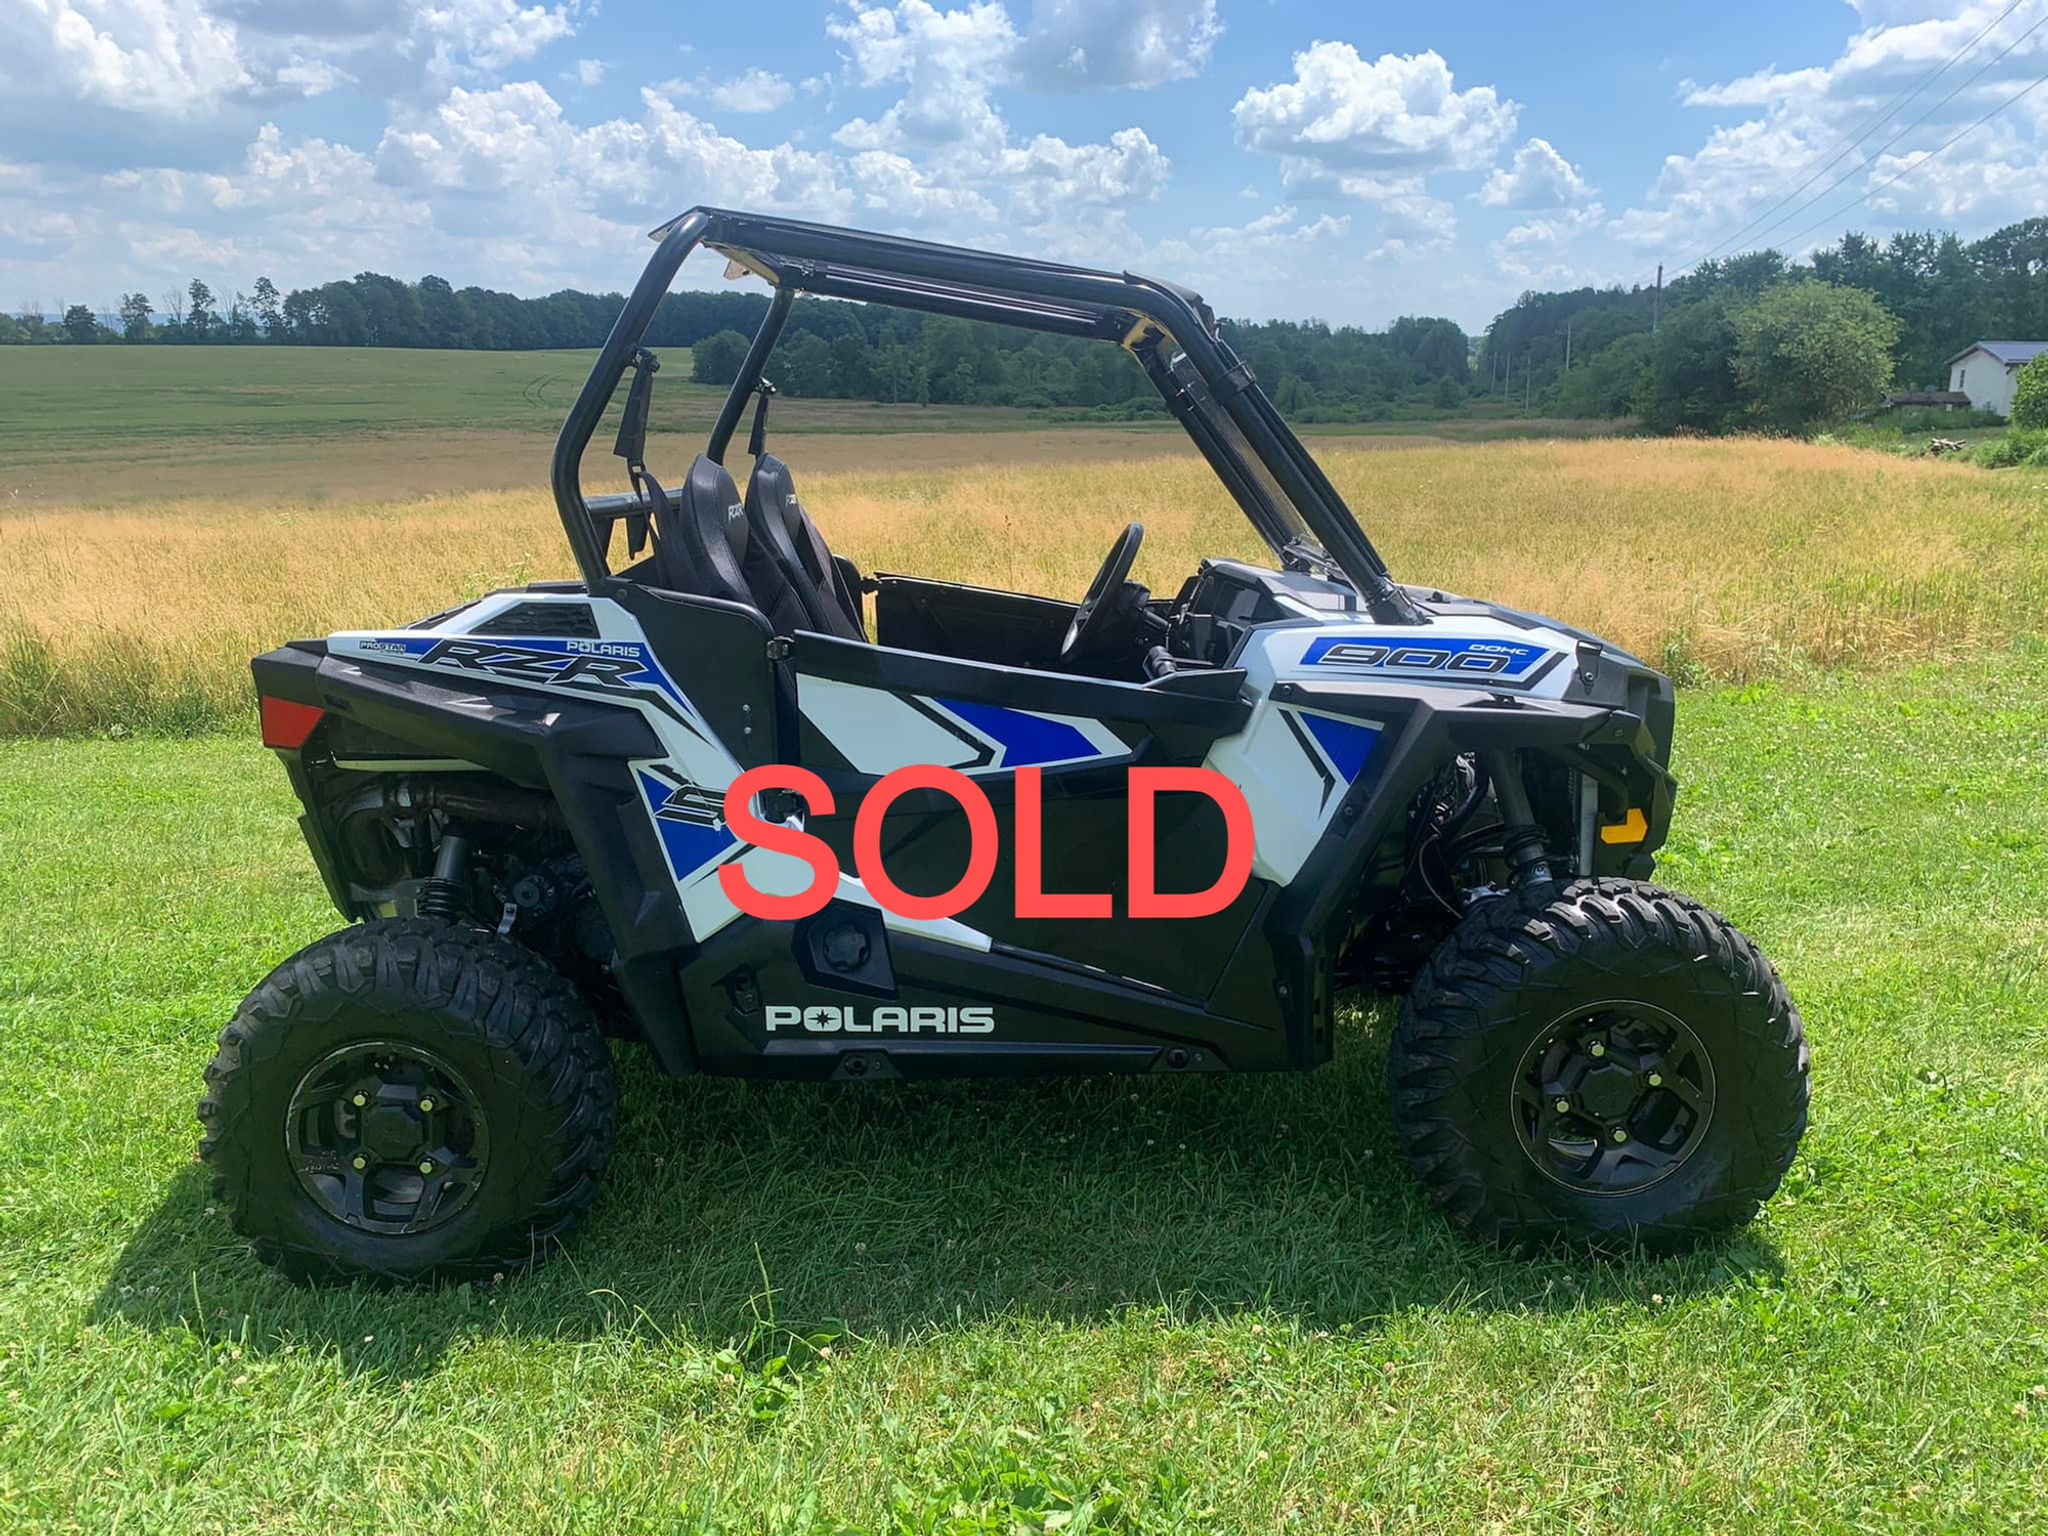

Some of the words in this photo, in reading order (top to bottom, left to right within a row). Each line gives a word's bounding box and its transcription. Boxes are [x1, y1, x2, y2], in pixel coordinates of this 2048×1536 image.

[359, 641, 406, 651] PROSTAR
[566, 641, 641, 657] POLARIS
[1468, 644, 1529, 656] DOHC
[417, 638, 649, 690] RZR
[1318, 644, 1510, 673] 900
[765, 1006, 995, 1033] POLARIS
